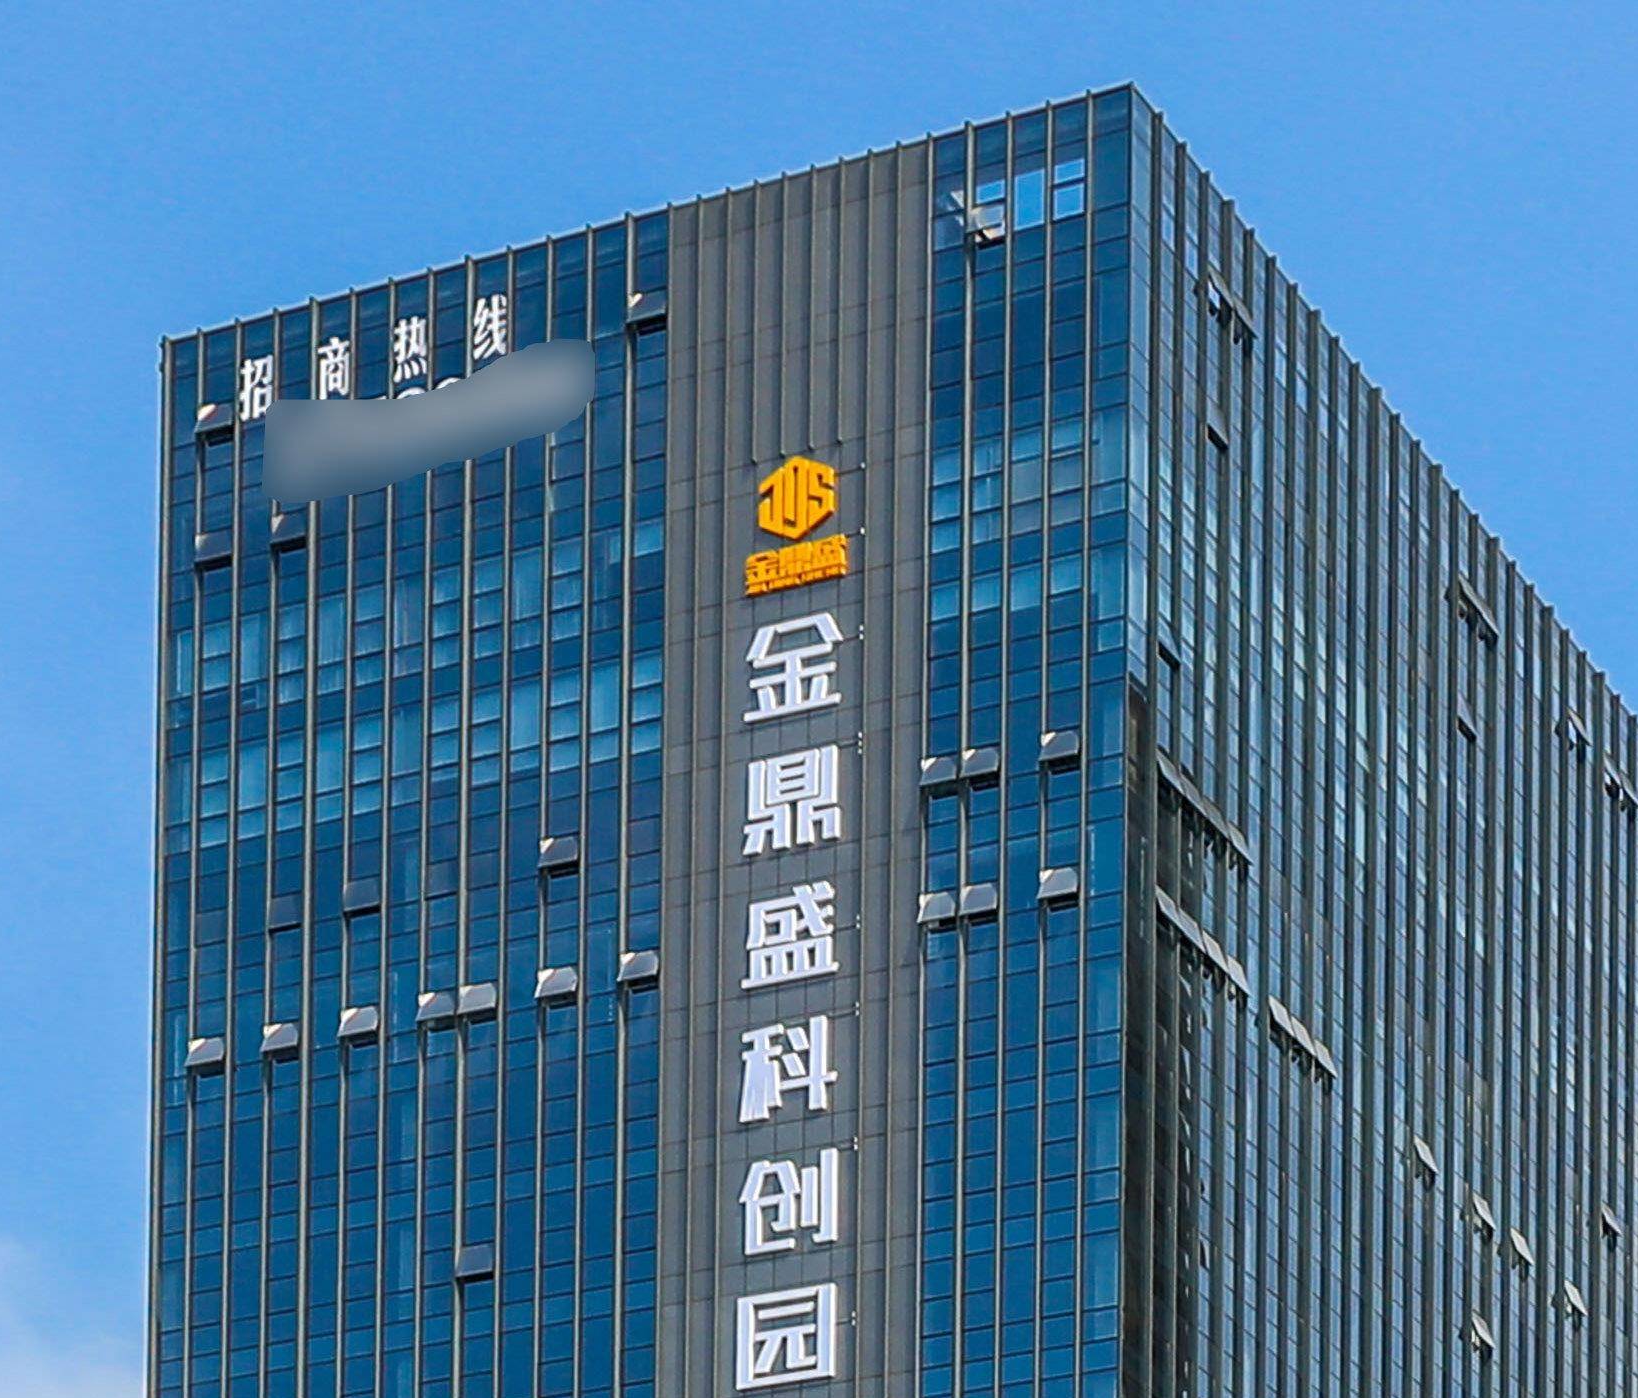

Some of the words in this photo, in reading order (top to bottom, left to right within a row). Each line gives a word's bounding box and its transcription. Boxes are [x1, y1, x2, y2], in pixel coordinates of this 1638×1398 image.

[239, 294, 509, 421] 招商热线
[735, 610, 845, 1391] 金鼎盛科创园
